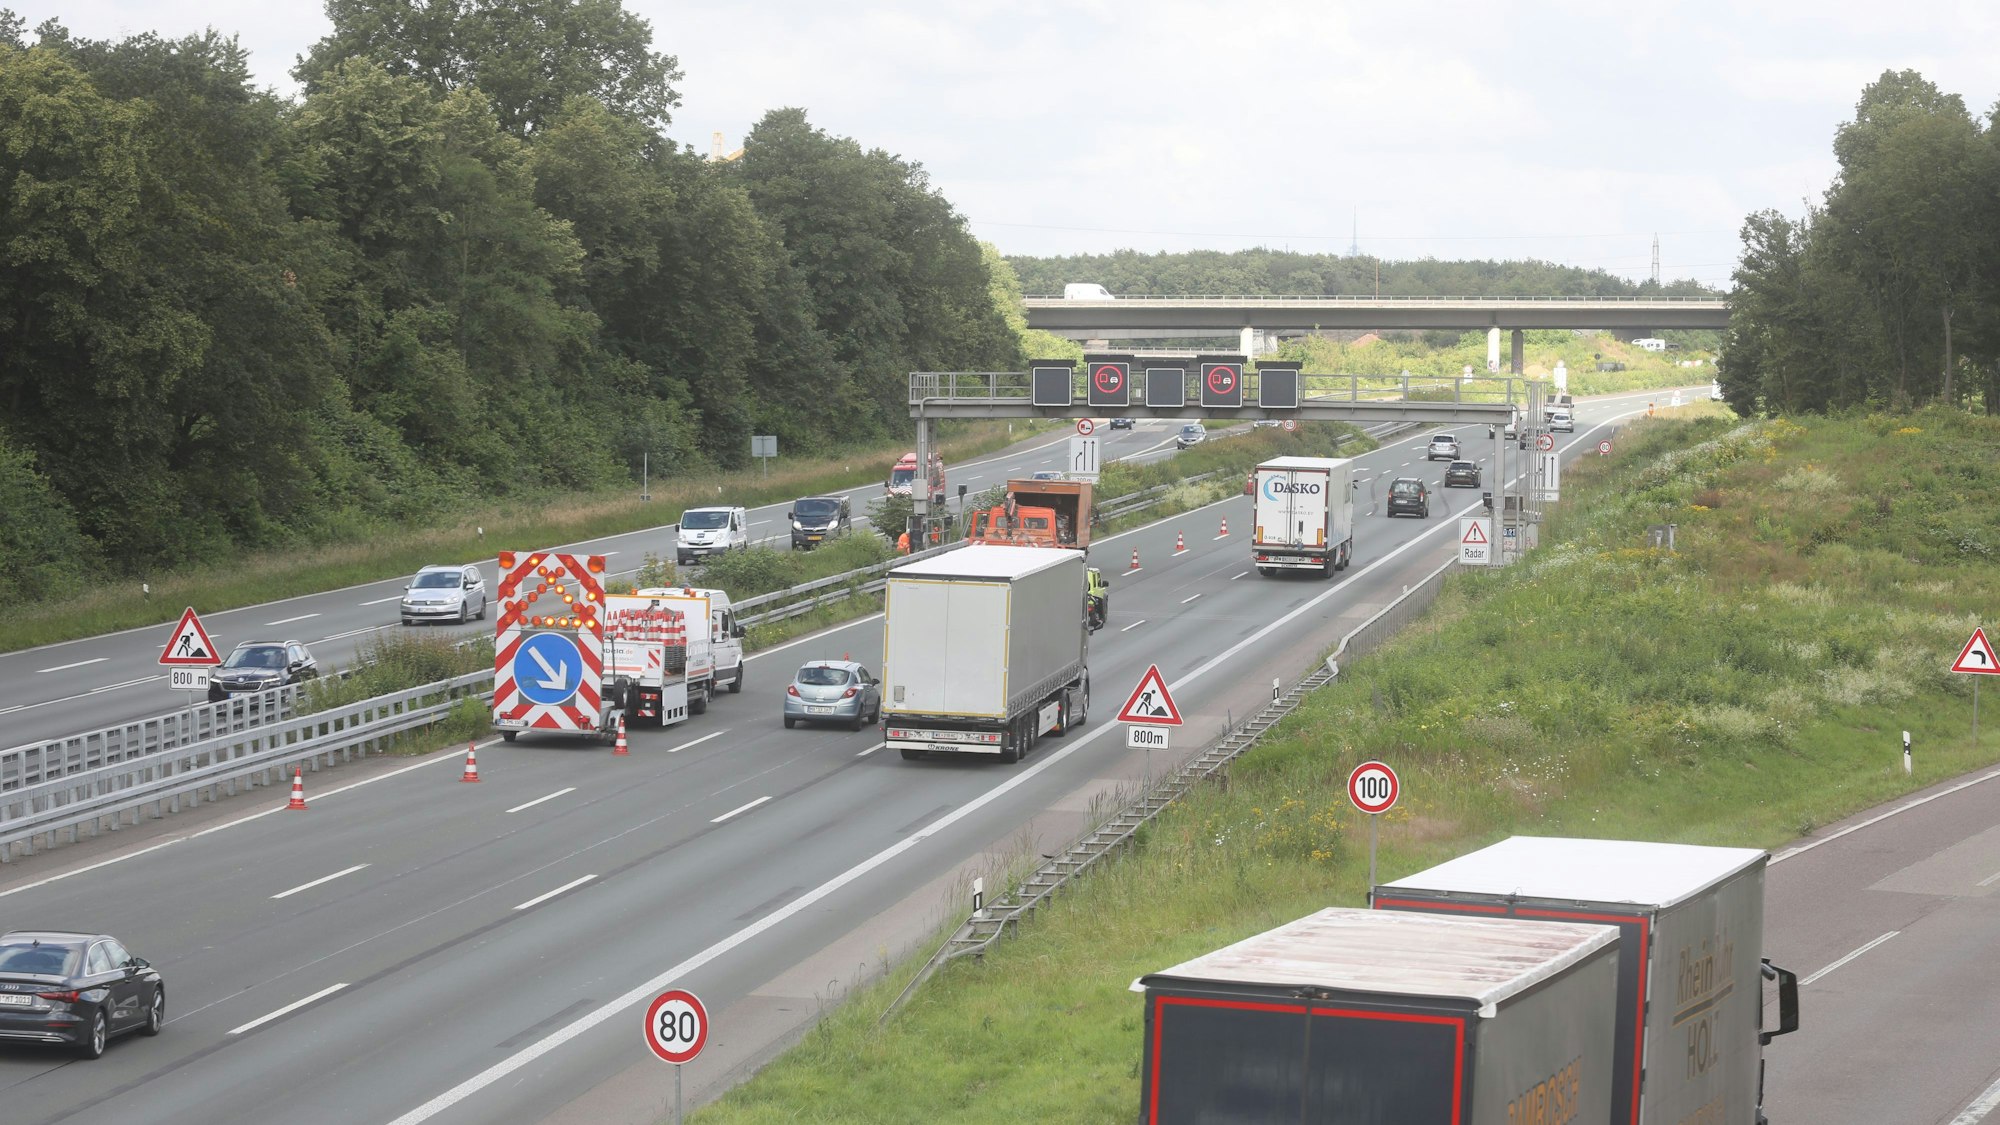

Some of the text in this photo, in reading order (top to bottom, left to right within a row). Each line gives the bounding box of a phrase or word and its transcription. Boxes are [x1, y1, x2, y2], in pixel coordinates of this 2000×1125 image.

[1273, 482, 1320, 495] DASKO
[1464, 548, 1484, 559] Radar
[173, 672, 206, 685] 800 m
[1133, 730, 1163, 745] 800m
[1359, 776, 1389, 799] 100
[660, 1010, 695, 1043] 80
